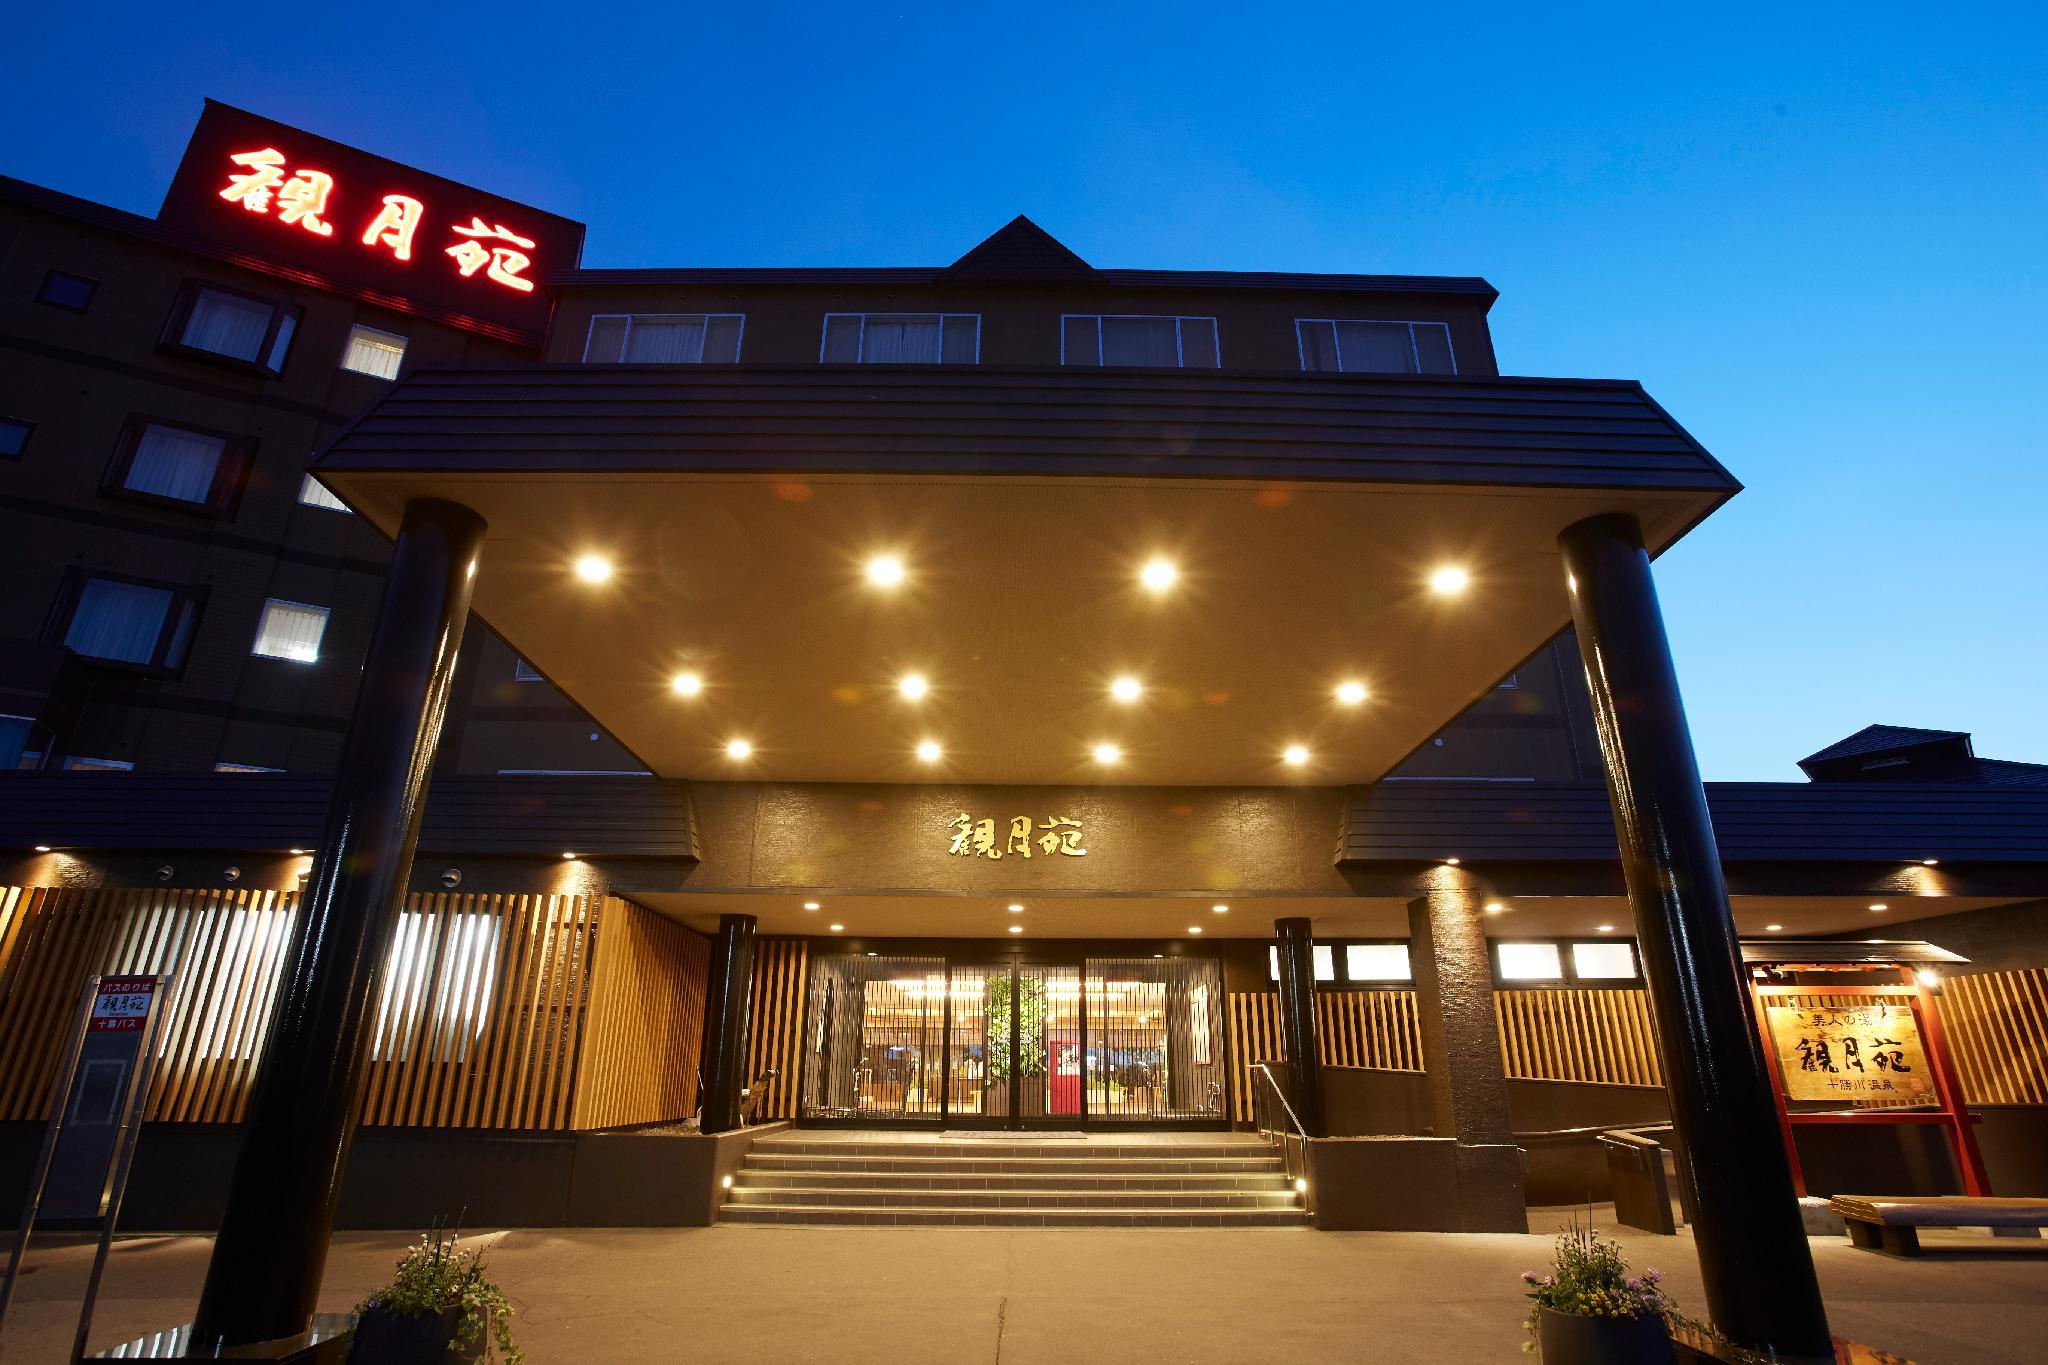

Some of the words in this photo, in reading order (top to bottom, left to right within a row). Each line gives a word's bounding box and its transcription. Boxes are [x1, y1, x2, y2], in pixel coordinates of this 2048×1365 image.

[218, 147, 537, 293] 観月苑
[947, 813, 1088, 860] 観月苑
[103, 983, 151, 993] バスのりば
[101, 995, 145, 1012] 観月苑
[1812, 1013, 1873, 1027] 美人の湯
[1795, 1037, 1912, 1074] 観月苑
[1827, 1080, 1895, 1092] 十勝川温泉
